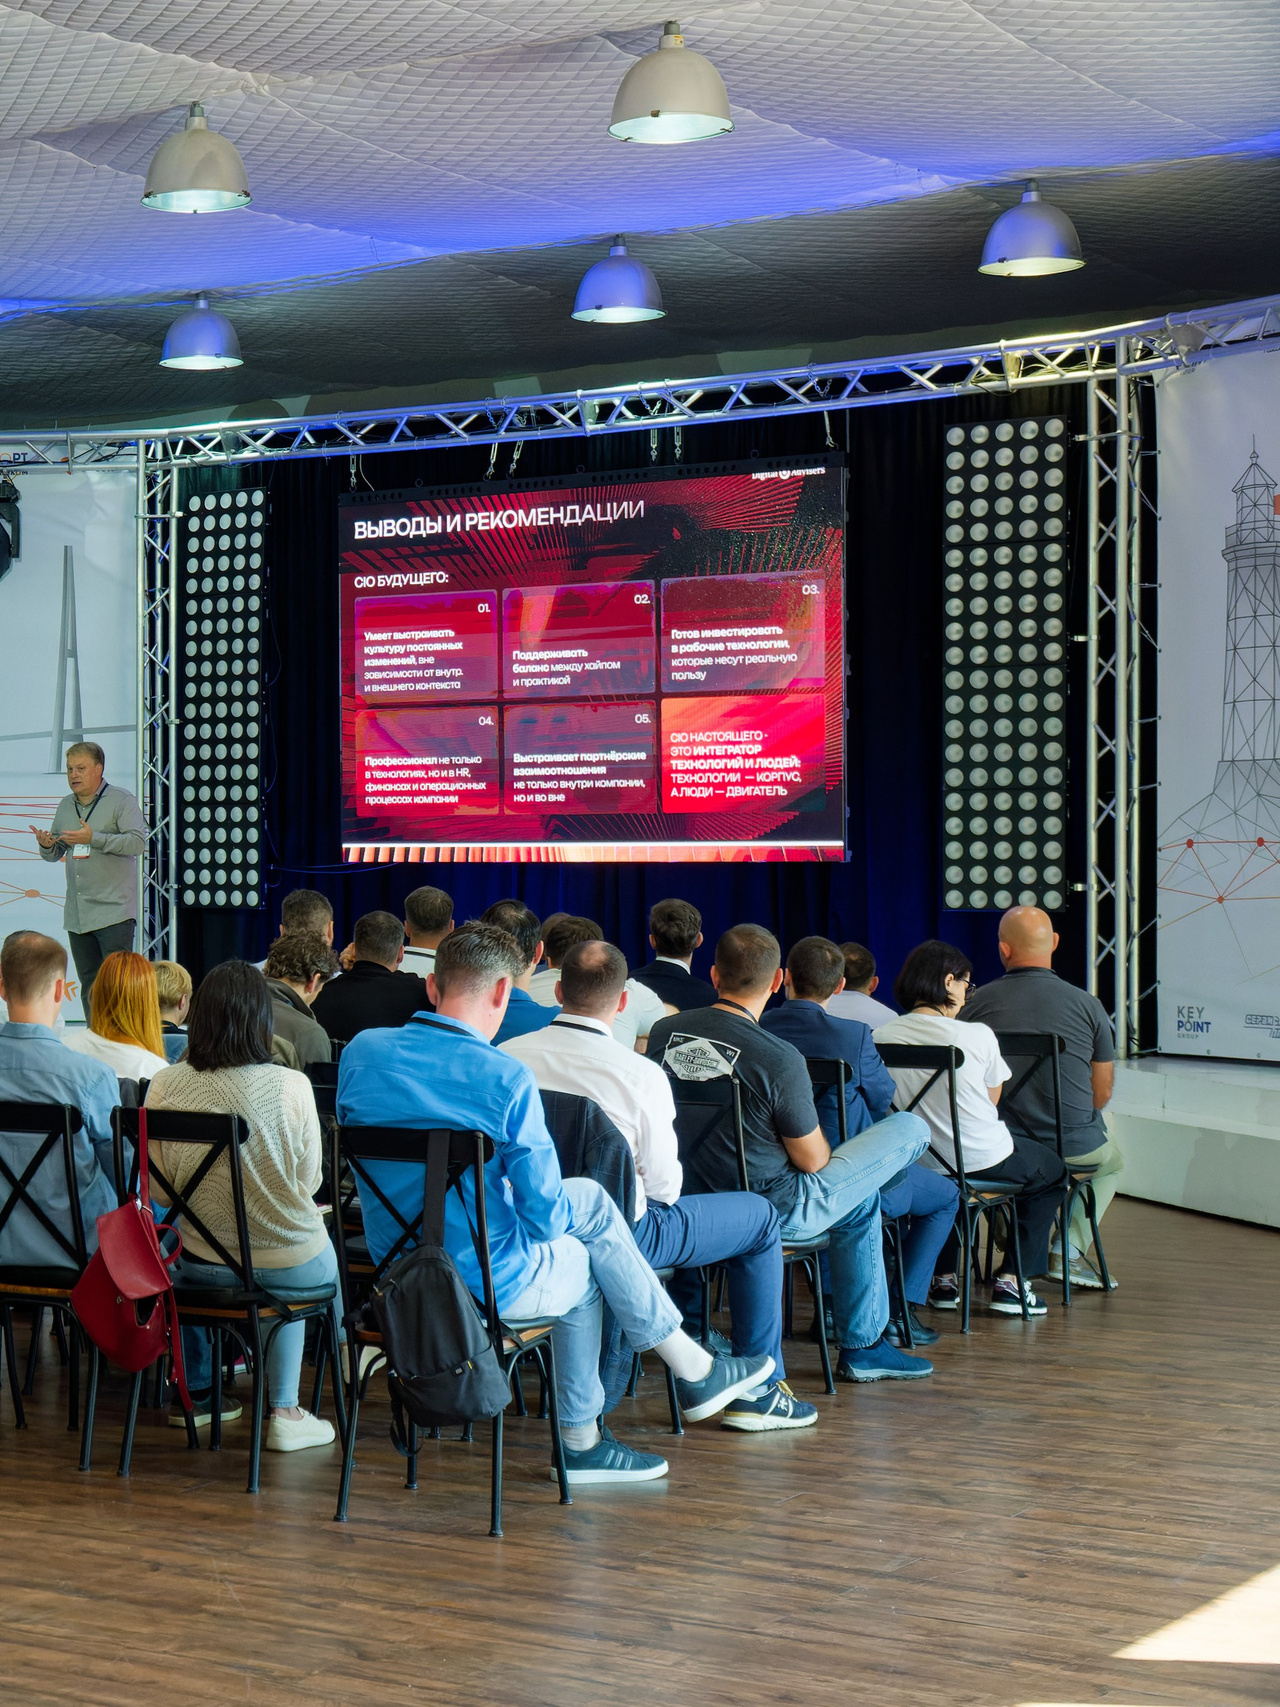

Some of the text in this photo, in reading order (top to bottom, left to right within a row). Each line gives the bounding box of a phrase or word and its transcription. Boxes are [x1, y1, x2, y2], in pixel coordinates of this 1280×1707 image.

[354, 500, 645, 539] ВЫВОДЫ И РЕКОМЕНДАЦИИ
[377, 571, 449, 588] БУДУЩЕГО:
[802, 584, 820, 595] 03.
[634, 594, 650, 604] 02.
[478, 603, 491, 613] 01.
[364, 630, 455, 641] Умеет выстраивать
[672, 626, 783, 639] Готов инвестировать
[364, 642, 463, 655] культуру постоянных
[672, 640, 790, 654] в рабочие технологии,
[513, 649, 588, 660] Поддерживать
[672, 653, 797, 667] которые несут реальную
[364, 655, 435, 667] изменений, вне
[513, 660, 620, 673] баланс между хайпом
[364, 668, 463, 679] зависимости от внутр.
[672, 671, 706, 681] пользу
[372, 682, 414, 692] внешнего
[416, 681, 460, 690] контекста
[521, 675, 570, 687] практикой
[479, 716, 494, 726] 04.
[635, 714, 651, 724] 05.
[690, 730, 763, 742] НАСТОЯЩЕГО
[670, 745, 762, 756] ЭТО ИНТЕГРАТОР
[365, 756, 437, 767] Профессионал
[450, 756, 482, 764] только
[513, 751, 646, 763] Выстраивает партнёрские
[671, 755, 801, 770] ТЕХНОЛОГИЙ И ЛЮДЕЙ:
[372, 769, 427, 779] технологиях,
[428, 770, 440, 778] но
[456, 768, 471, 778] HR,
[513, 766, 606, 776] взаимоотношения
[671, 773, 740, 783] ТЕХНОЛОГИИ
[757, 772, 802, 783] КОРПУС,
[365, 782, 411, 792] финансах
[420, 782, 486, 792] операционных
[514, 779, 646, 789] не только внутри компании,
[726, 786, 788, 797] ДВИГАТЕЛЬ
[365, 796, 458, 805] процессах компании
[514, 794, 566, 802] но и во вне
[1177, 1006, 1205, 1019] KEY
[1177, 1020, 1211, 1033] POINT
